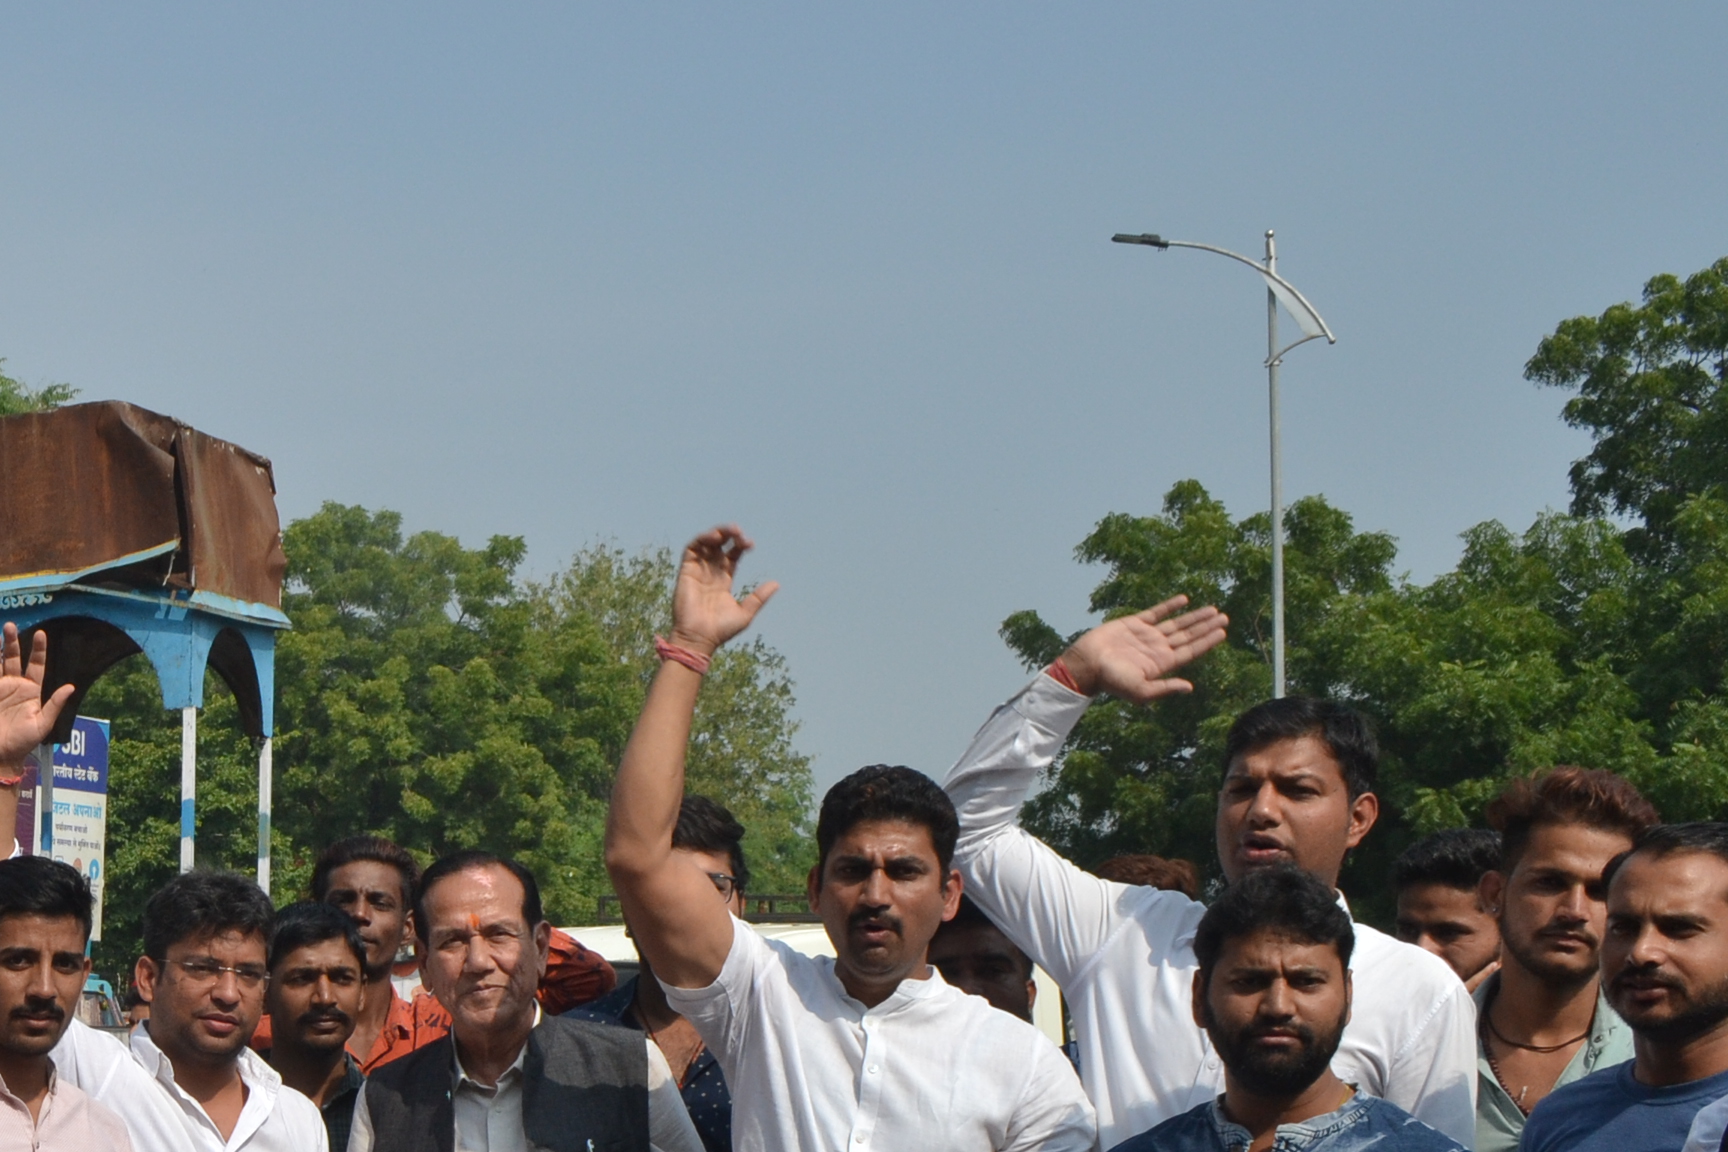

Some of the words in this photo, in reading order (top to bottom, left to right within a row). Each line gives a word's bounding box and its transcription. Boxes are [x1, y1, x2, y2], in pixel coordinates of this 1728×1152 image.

[74, 765, 87, 781] स्टेट
[73, 802, 102, 819] अपनाओ
[74, 825, 88, 833] बचाओ
